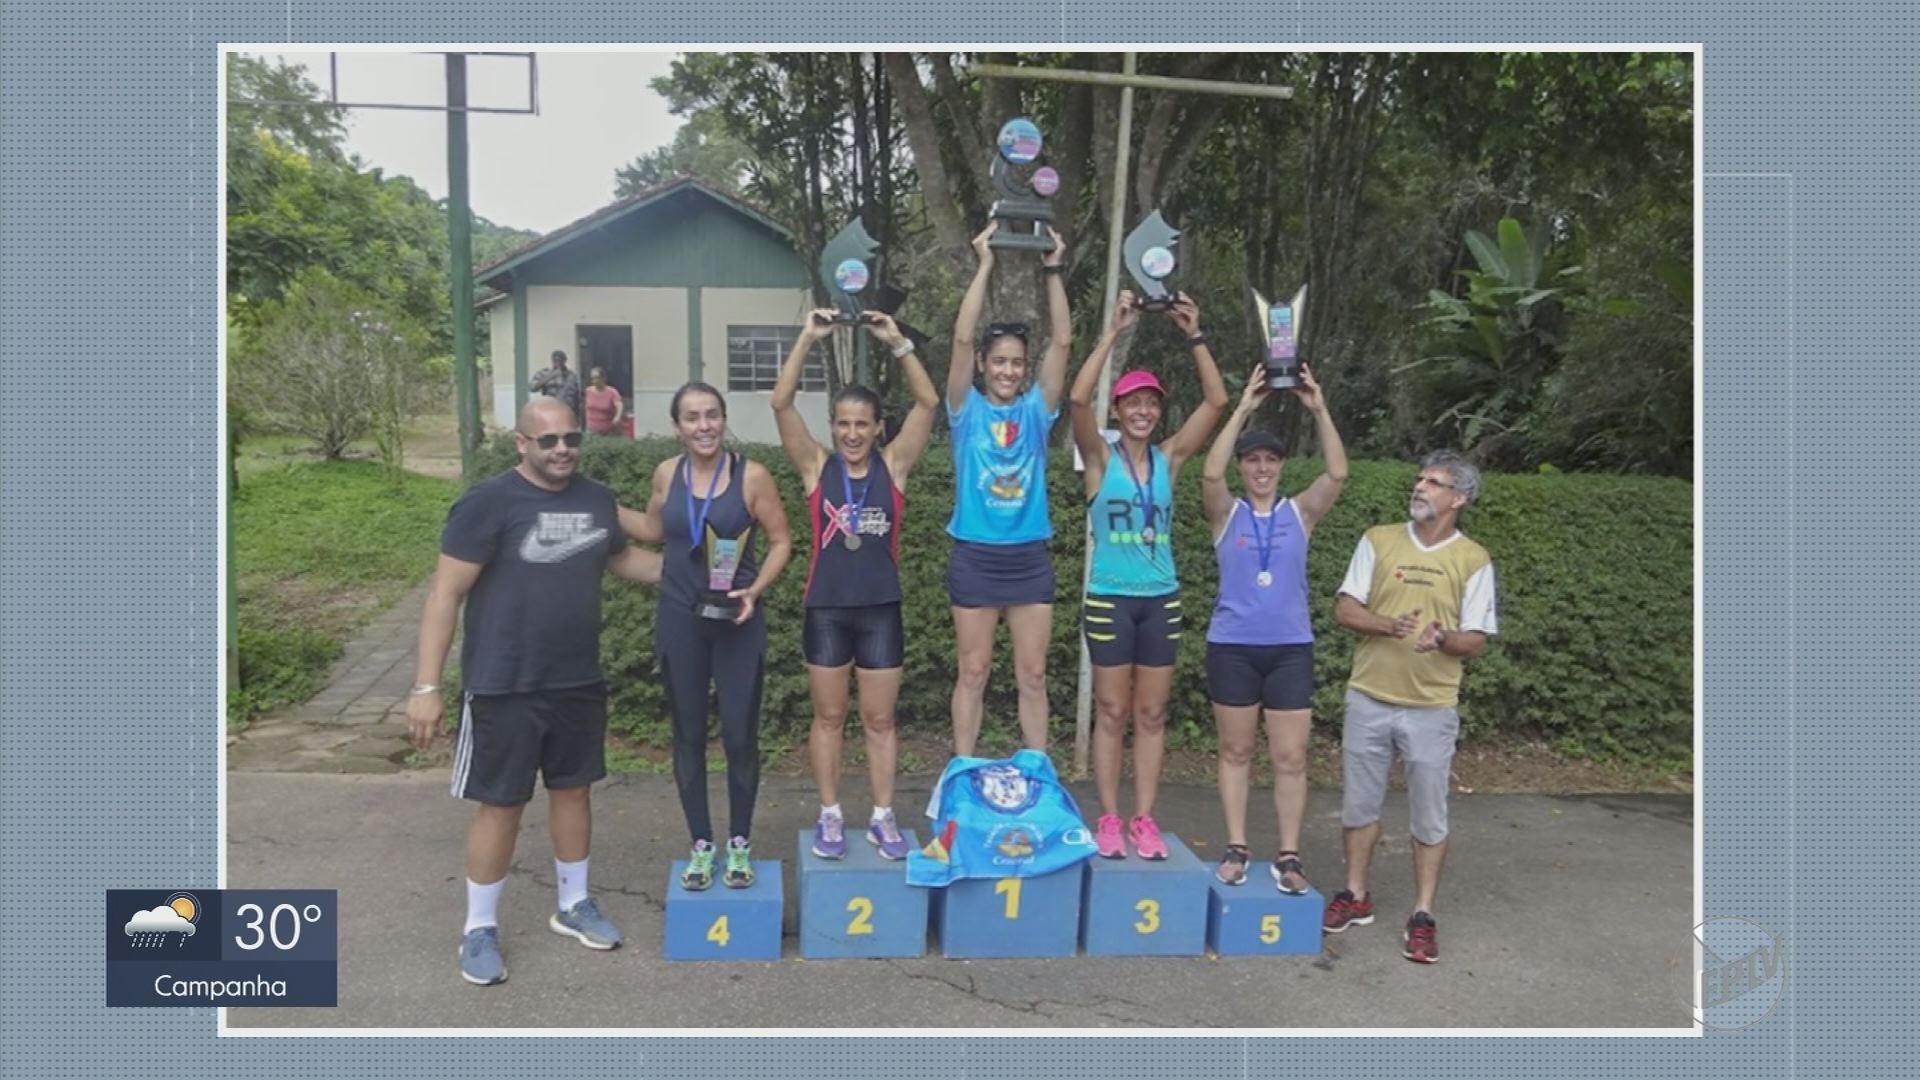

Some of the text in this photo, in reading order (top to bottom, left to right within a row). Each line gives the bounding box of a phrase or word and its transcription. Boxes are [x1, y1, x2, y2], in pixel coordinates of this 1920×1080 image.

[846, 897, 874, 936] 2
[994, 878, 1022, 919] 1
[706, 915, 731, 946] 4
[1134, 899, 1160, 935] 3
[1260, 914, 1281, 945] 5
